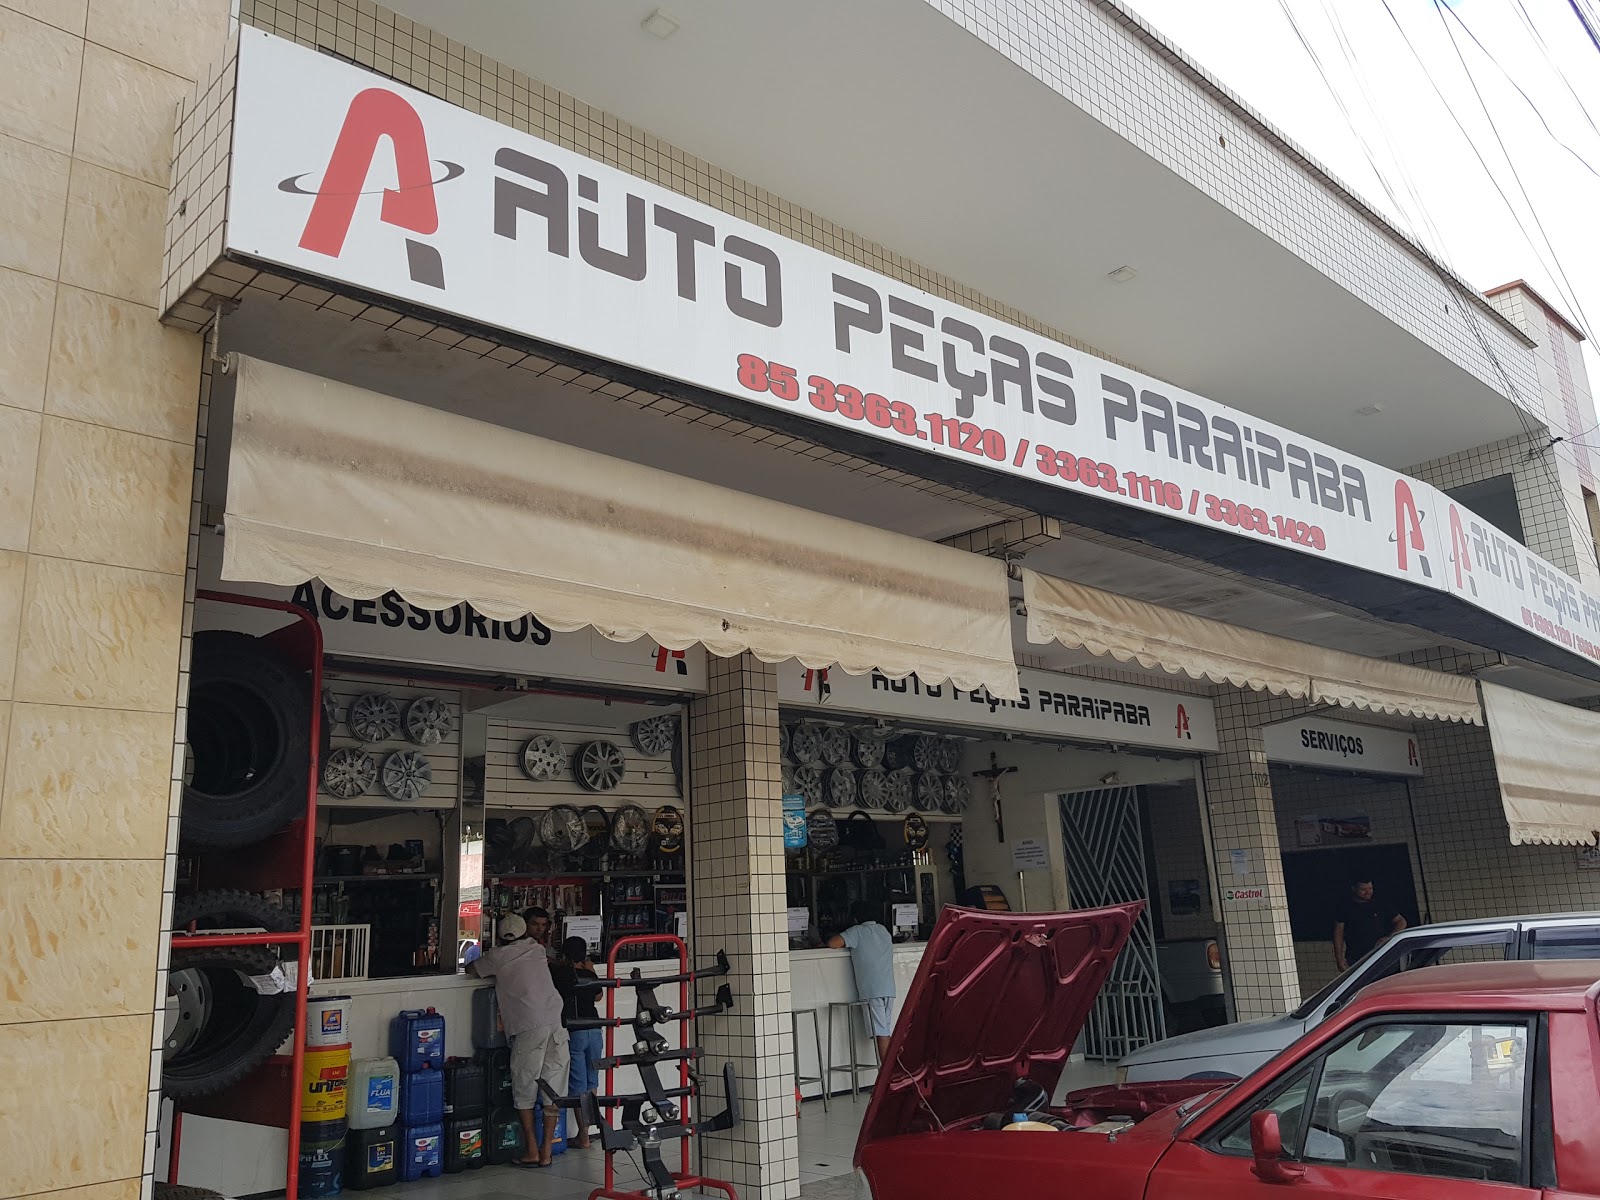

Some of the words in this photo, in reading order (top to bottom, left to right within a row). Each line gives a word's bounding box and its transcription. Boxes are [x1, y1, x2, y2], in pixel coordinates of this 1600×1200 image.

[494, 147, 782, 328] AUTO
[832, 273, 1077, 426] PEÇAS
[1100, 373, 1372, 522] PARAIPABA
[737, 353, 799, 401] 85
[807, 375, 1006, 462] 3363.1120
[1036, 444, 1182, 511] 3363.1116
[1204, 494, 1326, 551] 3363.1429
[1470, 521, 1525, 591] AUTO
[1038, 690, 1151, 727] PARAIPABA
[1301, 729, 1363, 758] SERVIÇOS
[1234, 889, 1263, 900] Castrol
